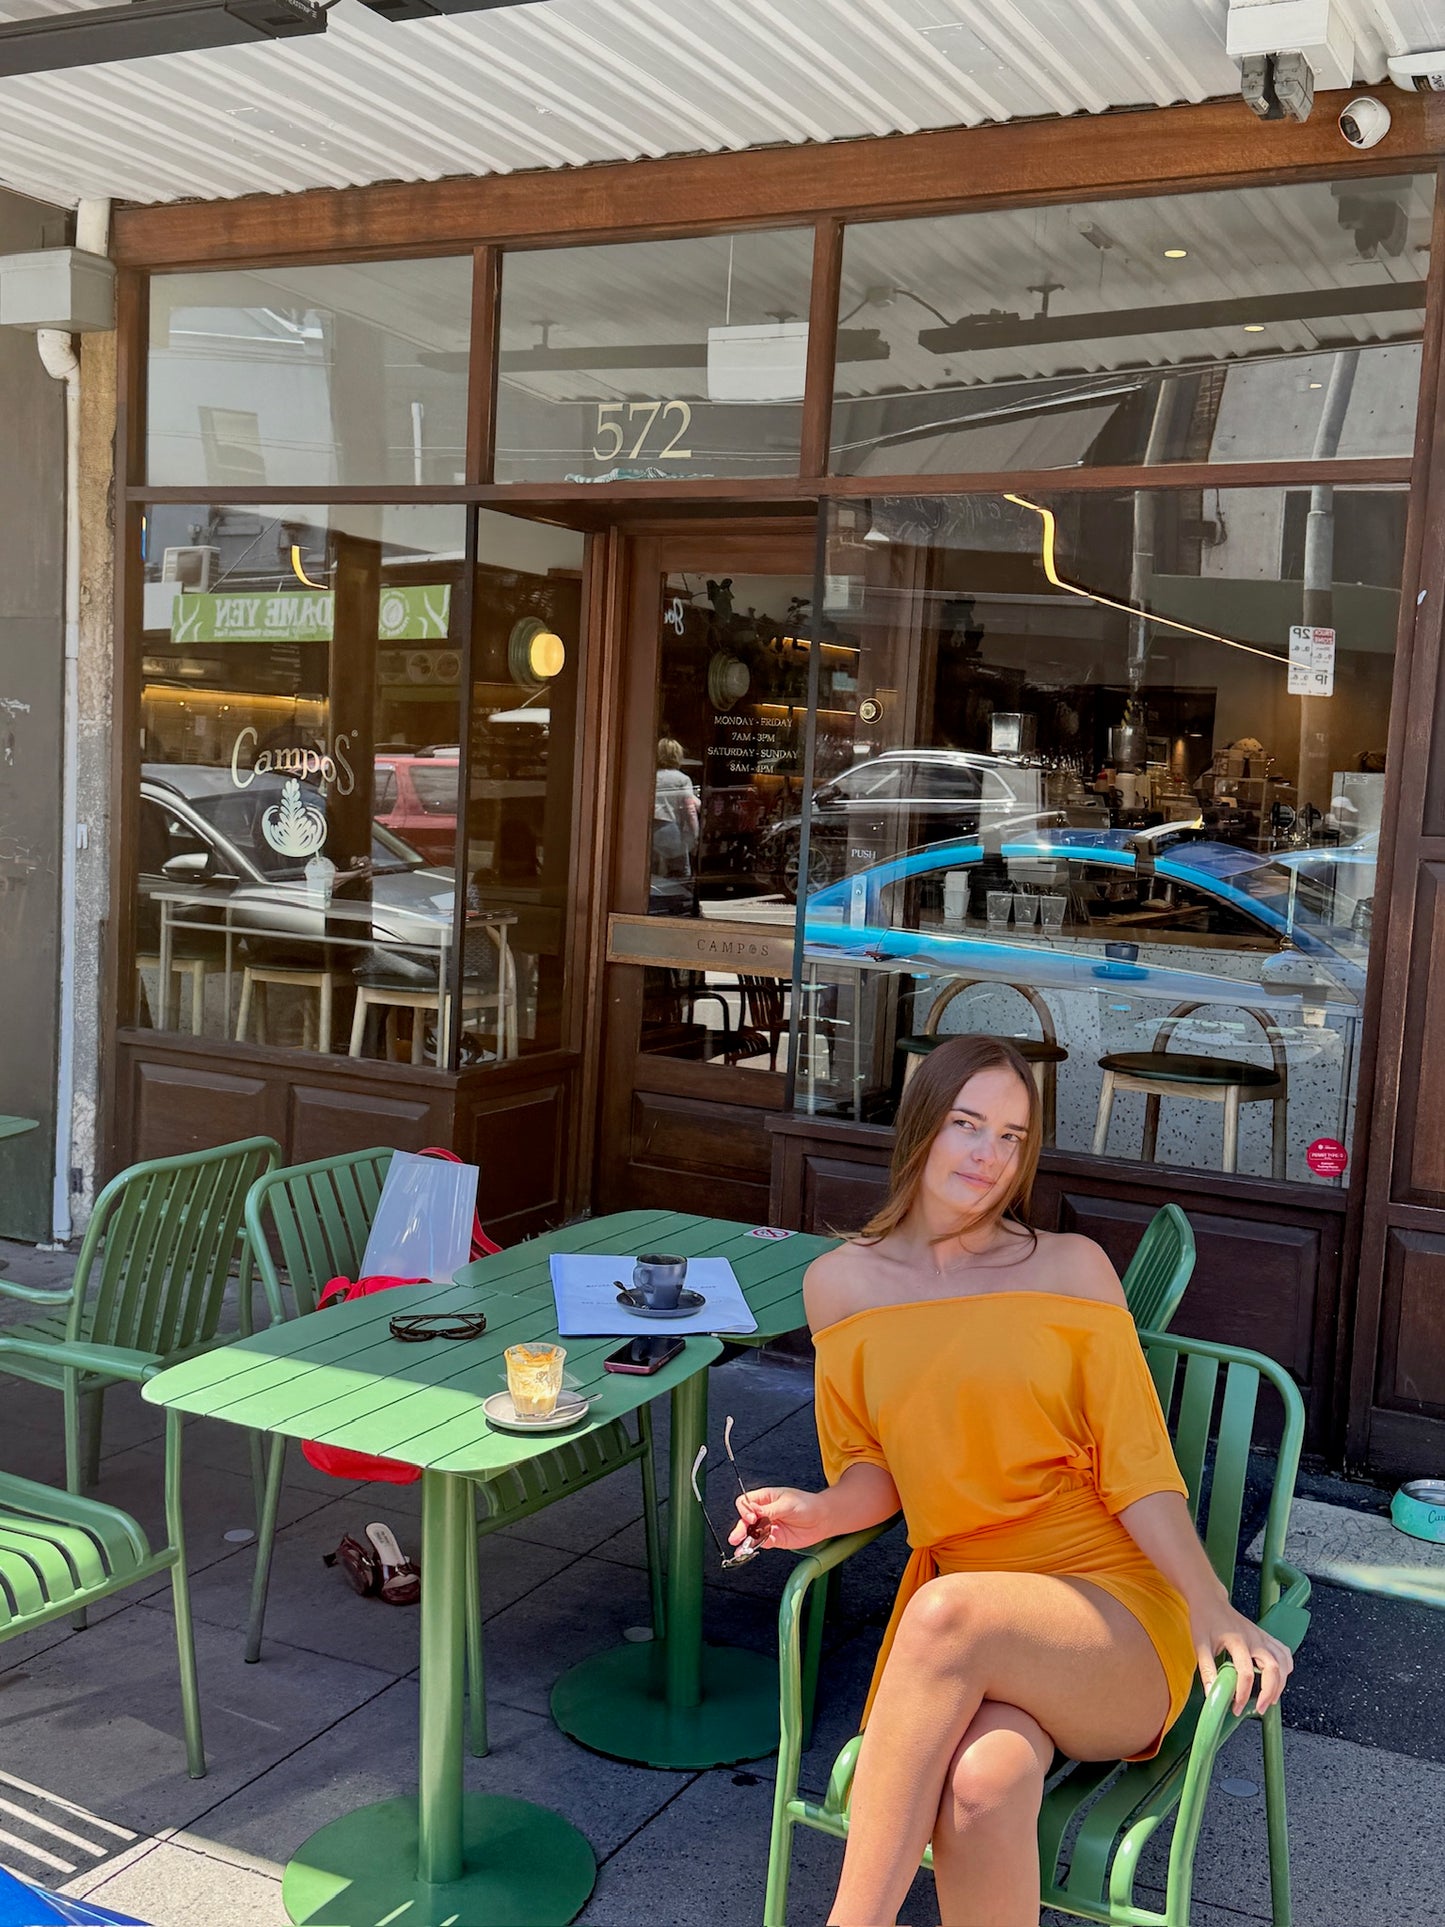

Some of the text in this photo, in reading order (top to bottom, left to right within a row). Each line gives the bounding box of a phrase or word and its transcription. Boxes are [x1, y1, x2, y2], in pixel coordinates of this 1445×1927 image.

[592, 400, 692, 461] 572
[714, 715, 754, 726] MONDAY
[760, 717, 793, 728] FRIDAY
[731, 731, 752, 741] 7AM
[756, 733, 775, 743] 3PM
[707, 746, 755, 757] SATURDAY
[760, 749, 798, 759] SUNDAY
[729, 762, 750, 772] 8AM
[755, 764, 774, 774] 4PM
[851, 848, 877, 859] PUSH
[697, 939, 769, 957] CAMPOS
